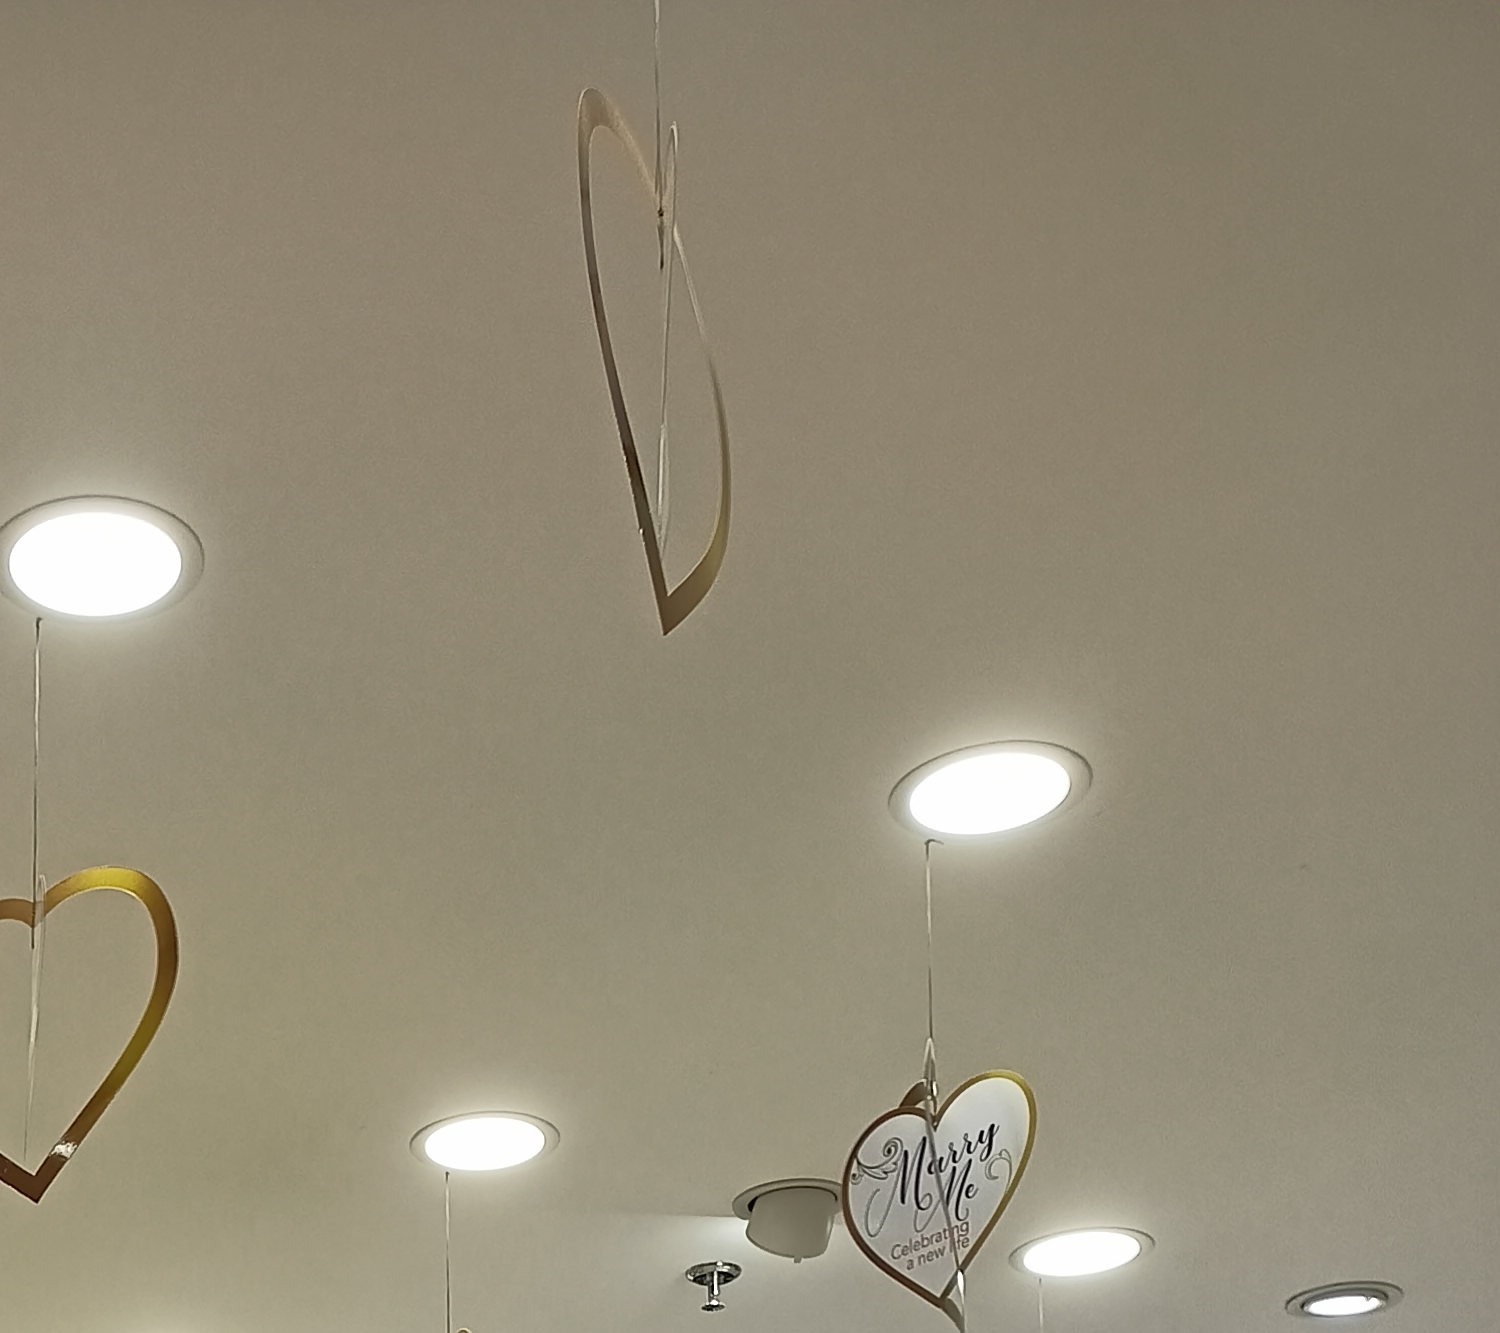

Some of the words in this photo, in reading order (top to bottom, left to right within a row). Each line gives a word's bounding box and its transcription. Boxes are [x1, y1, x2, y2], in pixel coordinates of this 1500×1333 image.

[865, 1123, 1000, 1237] Marry
[914, 1159, 978, 1232] Me
[906, 1259, 914, 1270] a
[917, 1246, 946, 1266] new
